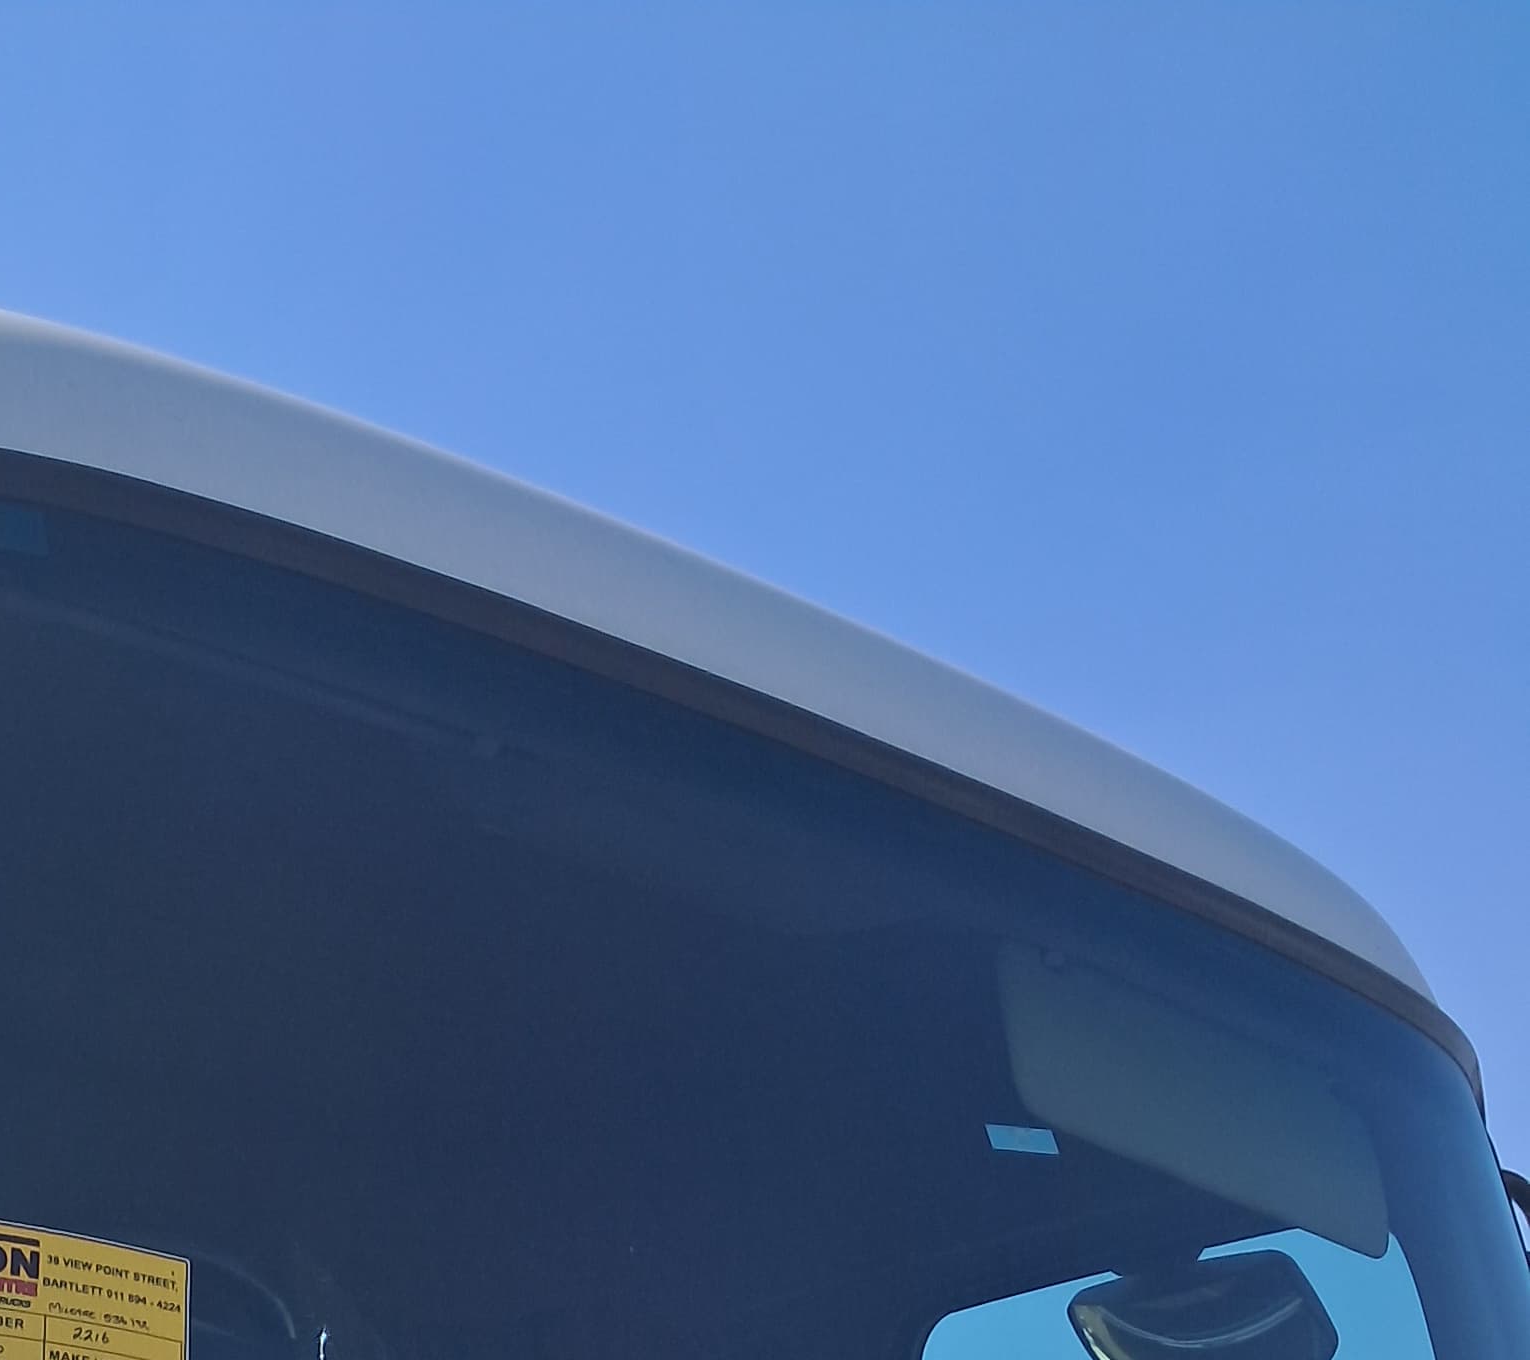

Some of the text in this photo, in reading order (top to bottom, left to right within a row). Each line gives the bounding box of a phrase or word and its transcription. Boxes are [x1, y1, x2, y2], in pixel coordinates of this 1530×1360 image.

[63, 1257, 93, 1271] VIEW
[95, 1263, 130, 1280] POINT
[42, 1277, 104, 1297] BARTLETT
[106, 1288, 125, 1302] 011
[72, 1326, 109, 1345] 2216
